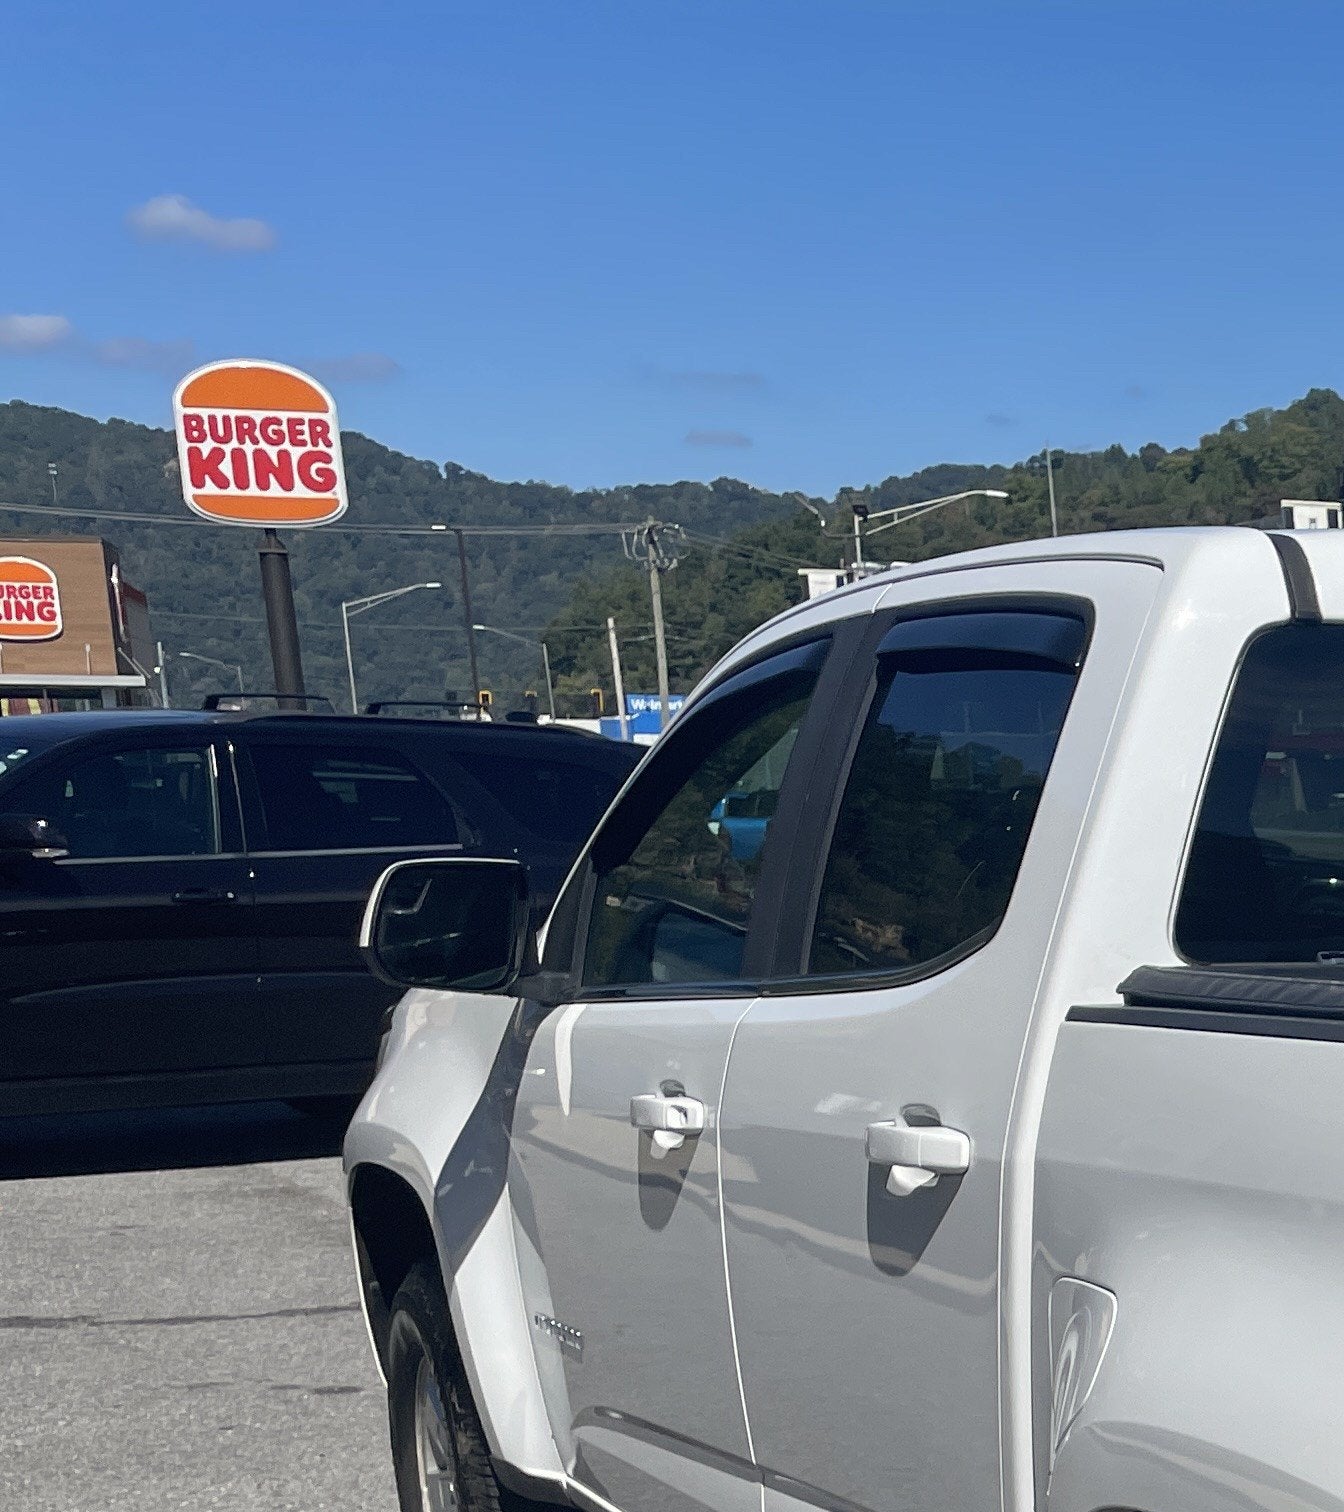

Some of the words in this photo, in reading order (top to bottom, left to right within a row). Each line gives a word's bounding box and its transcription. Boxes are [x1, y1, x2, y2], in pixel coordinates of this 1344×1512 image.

[183, 414, 333, 448] BURGER
[187, 446, 338, 493] KING
[0, 585, 55, 600] RGER
[0, 600, 57, 622] ING
